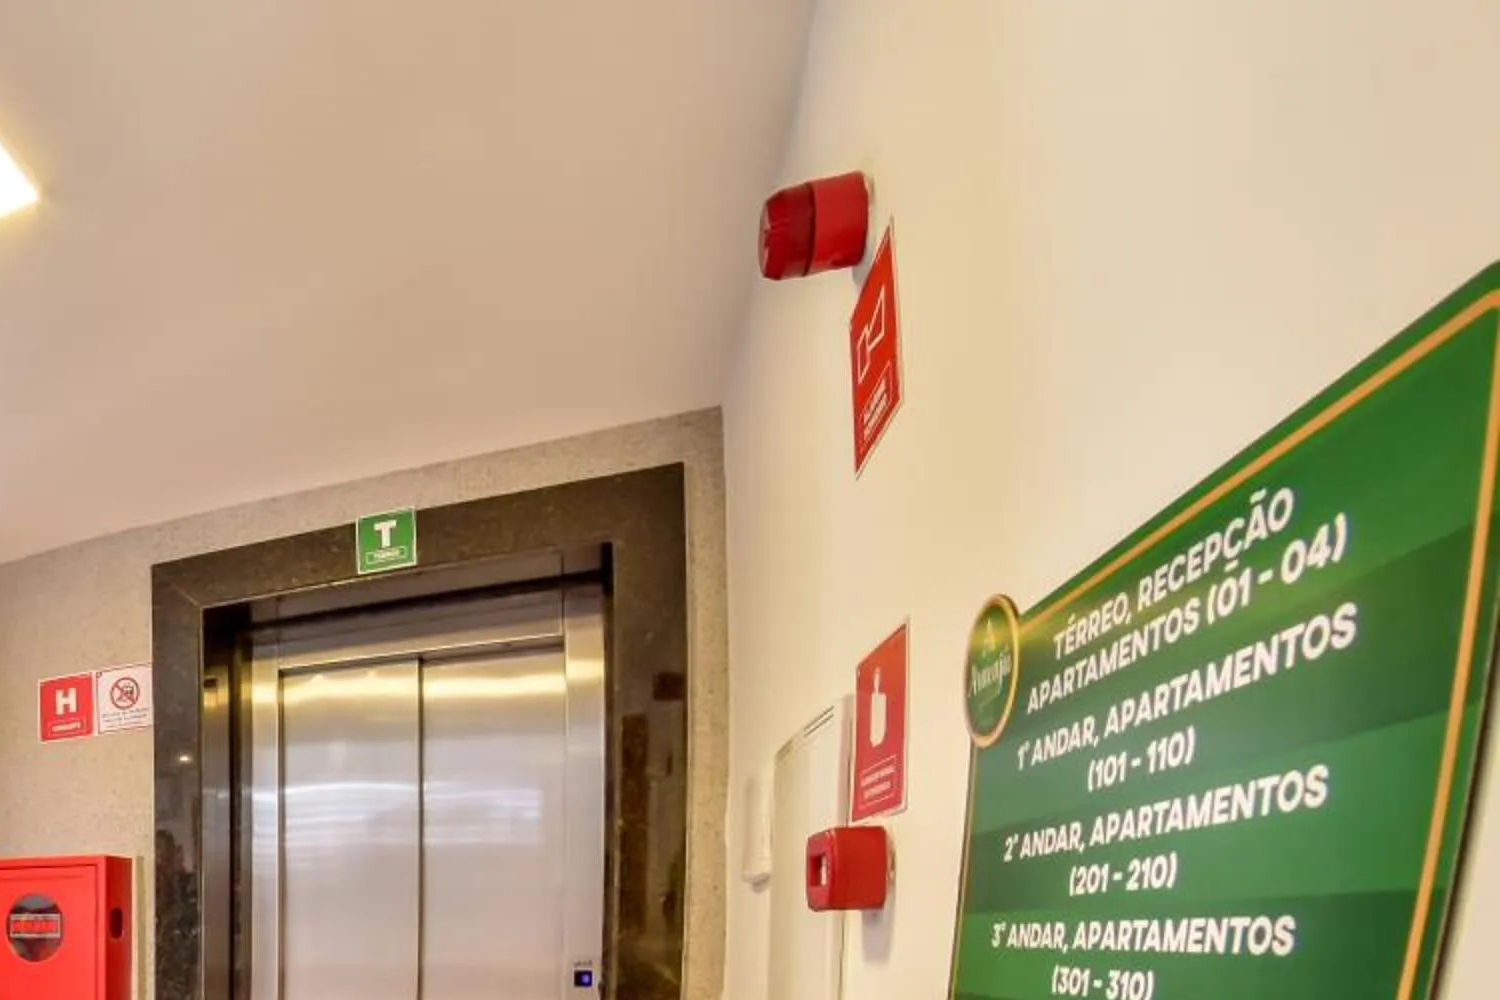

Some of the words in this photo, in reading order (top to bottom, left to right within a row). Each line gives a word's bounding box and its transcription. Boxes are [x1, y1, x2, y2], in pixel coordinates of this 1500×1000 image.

[373, 519, 397, 548] T
[1053, 591, 1131, 660] TÉRREO,
[1137, 487, 1294, 612] RECEPÇÃO
[1027, 597, 1200, 715] APARTAMENTOS
[1206, 567, 1252, 625] (01
[1280, 511, 1347, 584] 04)
[55, 687, 77, 715] H
[1031, 715, 1099, 768] ANDAR,
[1103, 602, 1358, 738] APARTAMENTOS
[1087, 751, 1128, 792] (101
[1147, 725, 1196, 774] 110)
[1019, 822, 1085, 860] ANDAR,
[1090, 764, 1329, 847] APARTAMENTOS
[1069, 863, 1110, 896] (201
[1125, 852, 1178, 890] 210)
[1006, 922, 1069, 953] ANDAR,
[1072, 915, 1296, 956] APARTAMENTOS
[1051, 965, 1090, 997] (301
